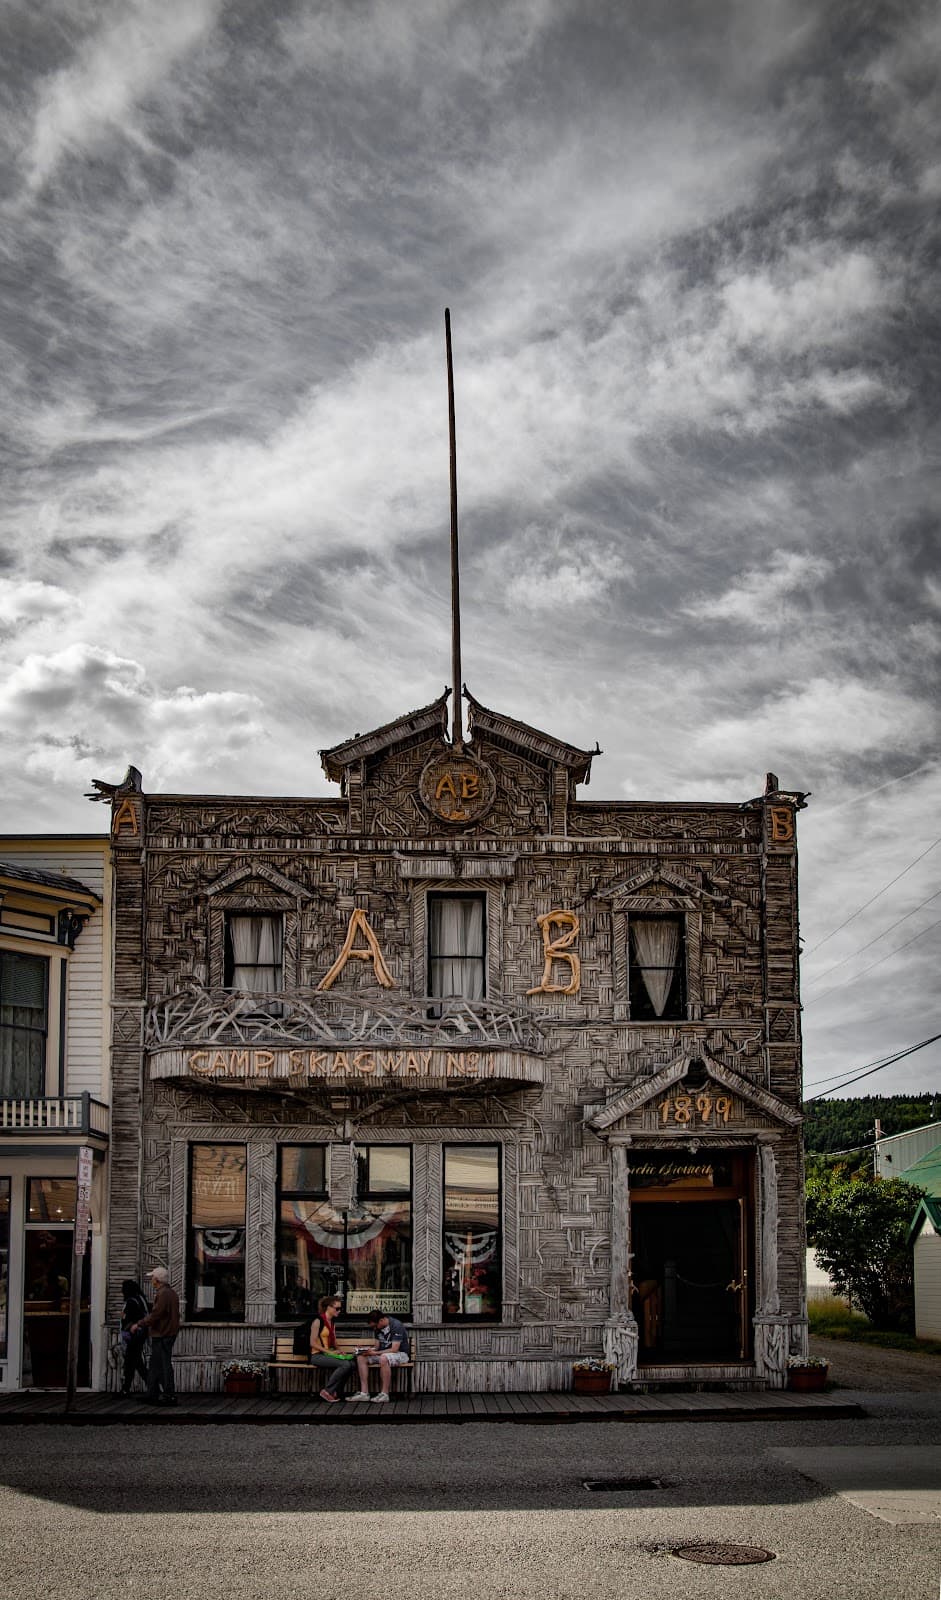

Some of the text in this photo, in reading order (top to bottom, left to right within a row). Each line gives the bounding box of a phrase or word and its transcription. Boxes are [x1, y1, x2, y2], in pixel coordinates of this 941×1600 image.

[435, 772, 480, 800] AB
[113, 799, 138, 836] A
[770, 805, 793, 841] B
[316, 908, 580, 995] A B
[188, 1050, 274, 1075] CAMP
[289, 1050, 432, 1076] SKAGWAY
[658, 1096, 732, 1123] 1899
